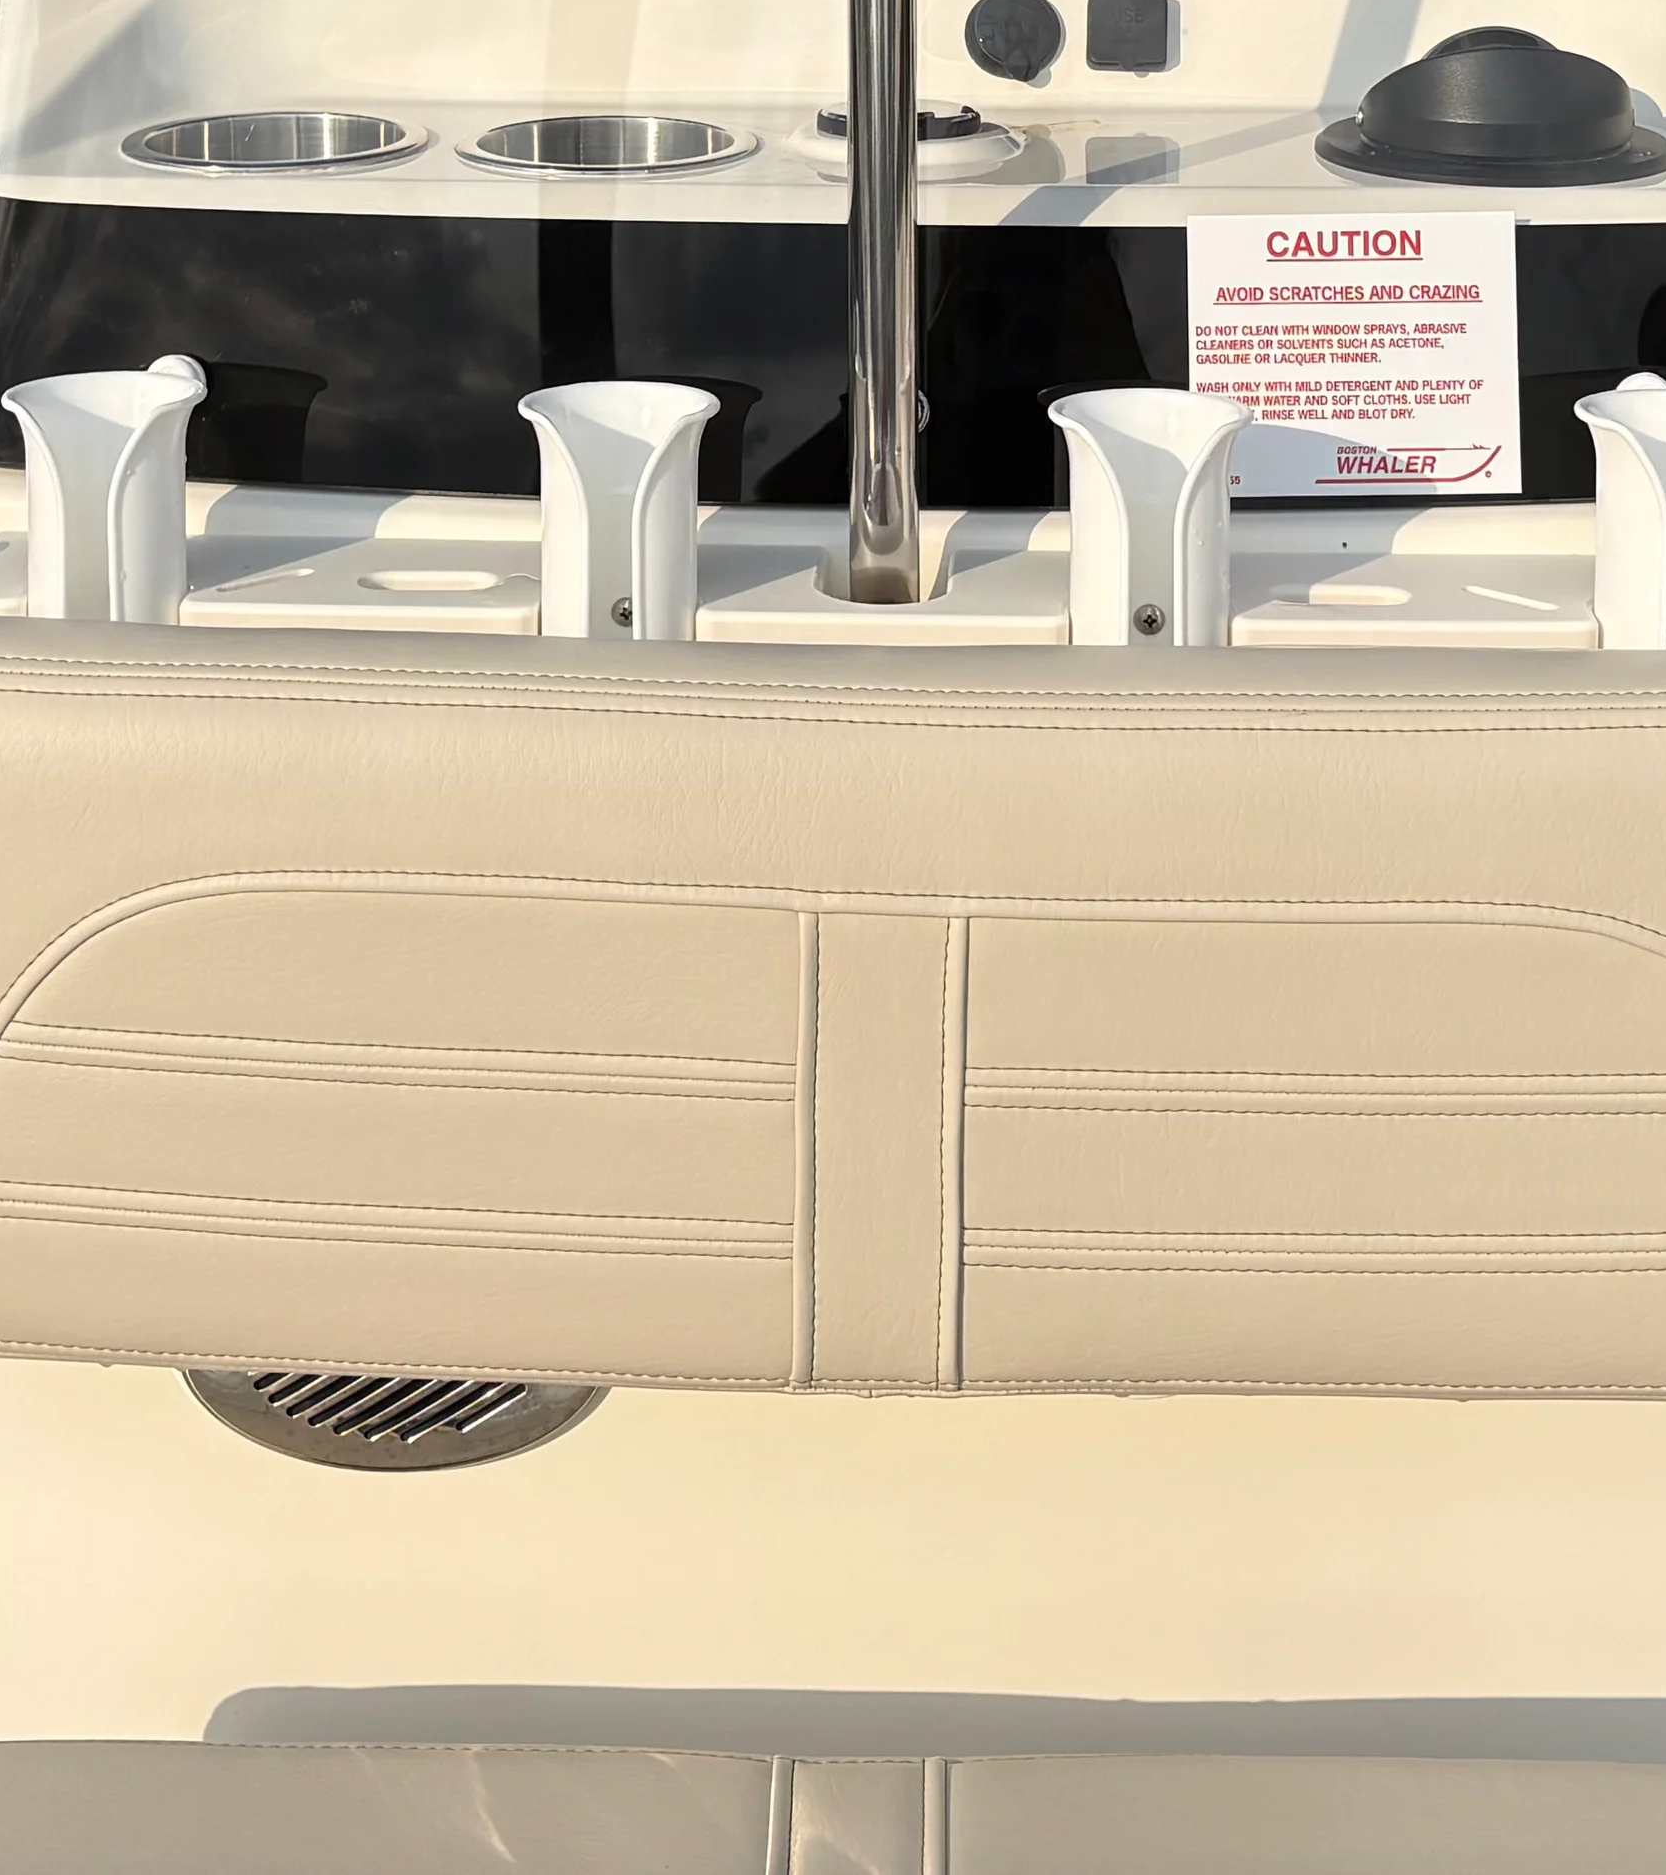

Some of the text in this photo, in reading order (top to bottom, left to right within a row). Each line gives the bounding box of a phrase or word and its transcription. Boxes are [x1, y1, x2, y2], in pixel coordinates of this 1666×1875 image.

[1266, 230, 1422, 258] CAUTION
[1216, 284, 1480, 302] AVOID SCRATCHES AND CRAZING
[1196, 323, 1467, 336] DO NOT CLEAN WITH WINDOW SPRAYS, ABRASIVE
[1196, 338, 1444, 350] CLEANERS OR SOLVENTS SUCH AS ACETONE,
[1196, 353, 1381, 366] GASOLINE OR LACQUER THINNER.
[1196, 379, 1484, 393] WASH ONLY WITH MILD DETERGENT AND PLENTY OF
[1263, 396, 1301, 406] WATER
[1304, 395, 1328, 406] AND
[1331, 395, 1360, 406] SOFT
[1363, 394, 1411, 405] CLOTHS.
[1414, 394, 1436, 405] USE
[1439, 394, 1471, 404] LIGHT
[1262, 410, 1295, 420] RINSE
[1298, 409, 1328, 420] WELL
[1331, 409, 1354, 419] AND
[1358, 409, 1387, 419] BLOT
[1390, 408, 1415, 419] DRY.
[1337, 446, 1377, 455] BOSTON
[1336, 455, 1437, 474] WHALER
